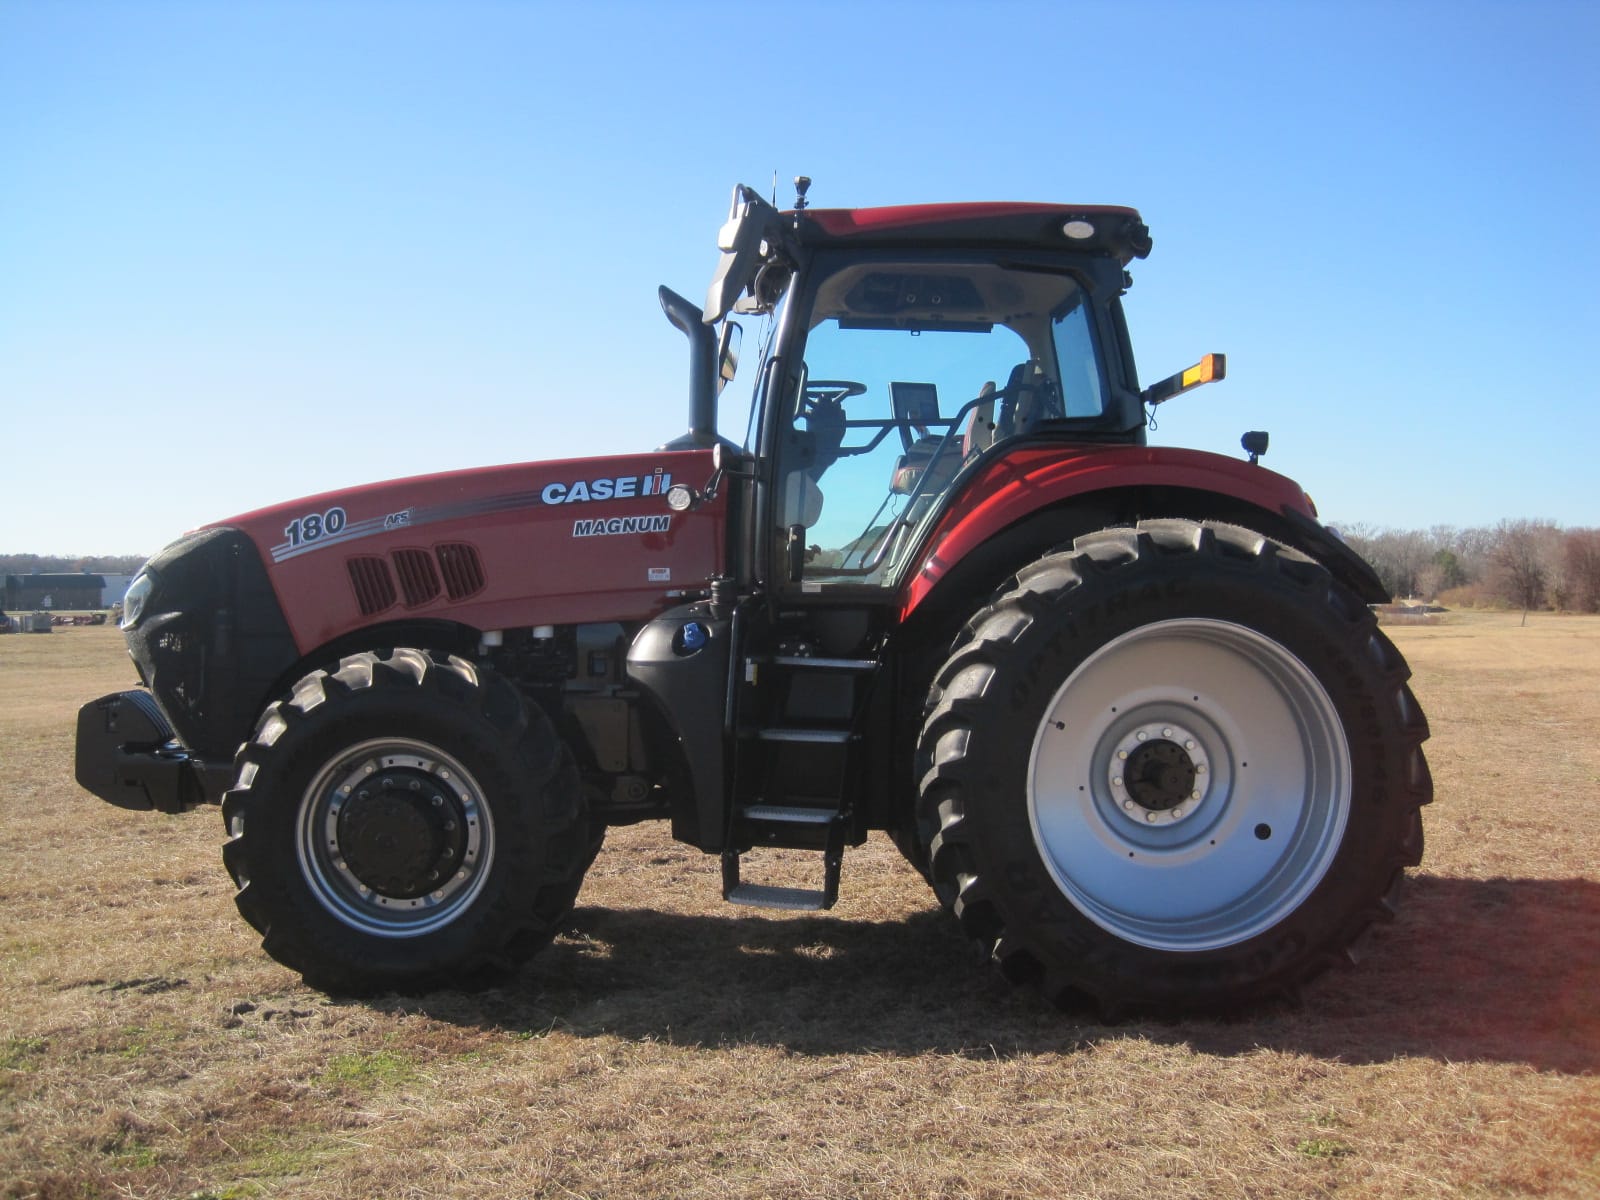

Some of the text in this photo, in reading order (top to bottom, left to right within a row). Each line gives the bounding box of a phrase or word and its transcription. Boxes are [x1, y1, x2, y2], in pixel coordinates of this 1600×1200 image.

[541, 476, 637, 505] CASE
[285, 507, 346, 548] 180
[573, 514, 671, 537] MAGNUM
